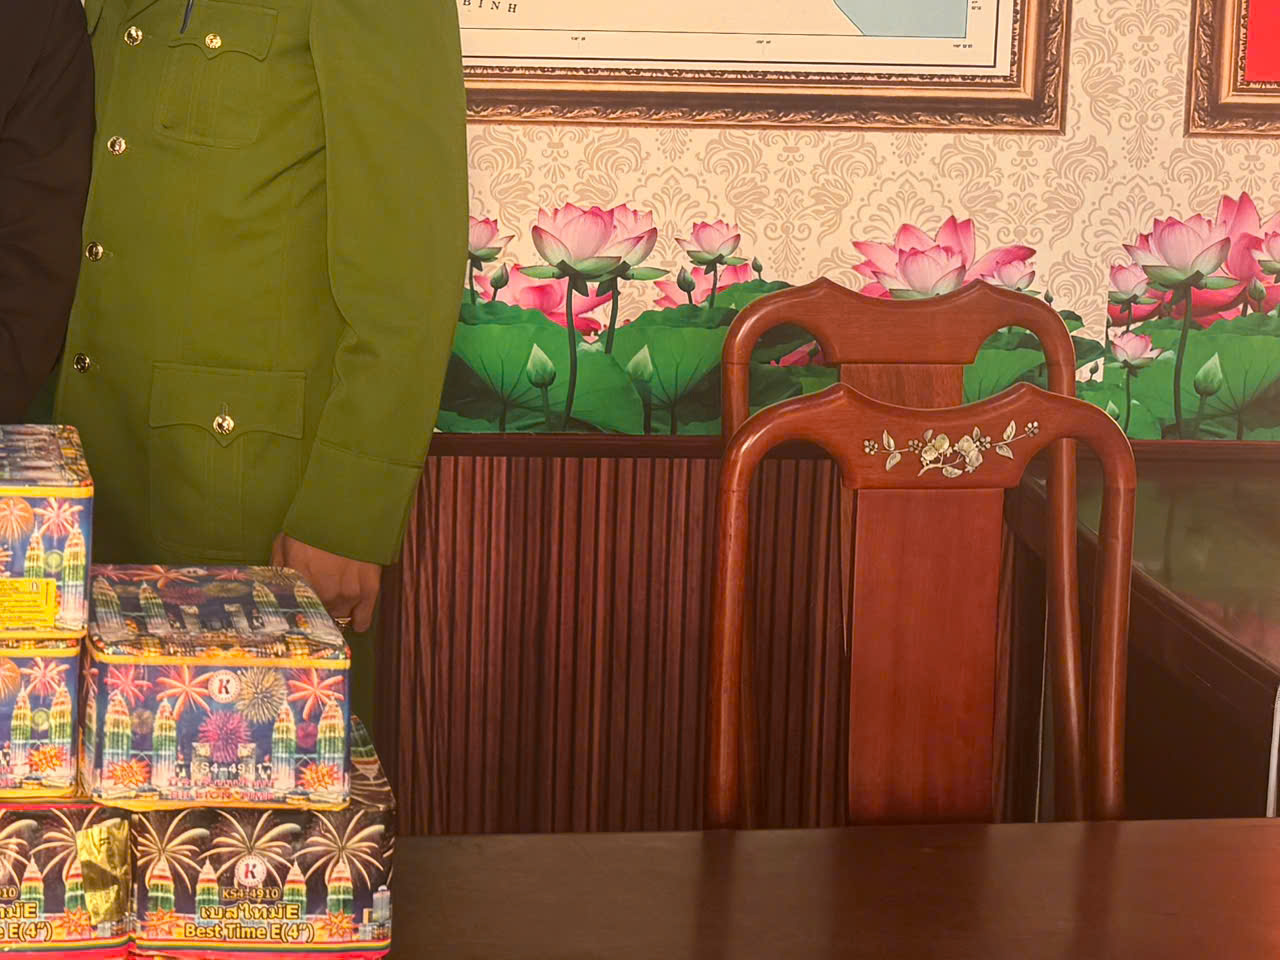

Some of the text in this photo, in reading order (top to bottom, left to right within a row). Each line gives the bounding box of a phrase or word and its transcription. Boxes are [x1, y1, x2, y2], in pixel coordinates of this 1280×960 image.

[218, 677, 231, 695] K
[185, 924, 222, 938] Best
[226, 923, 267, 939] Time
